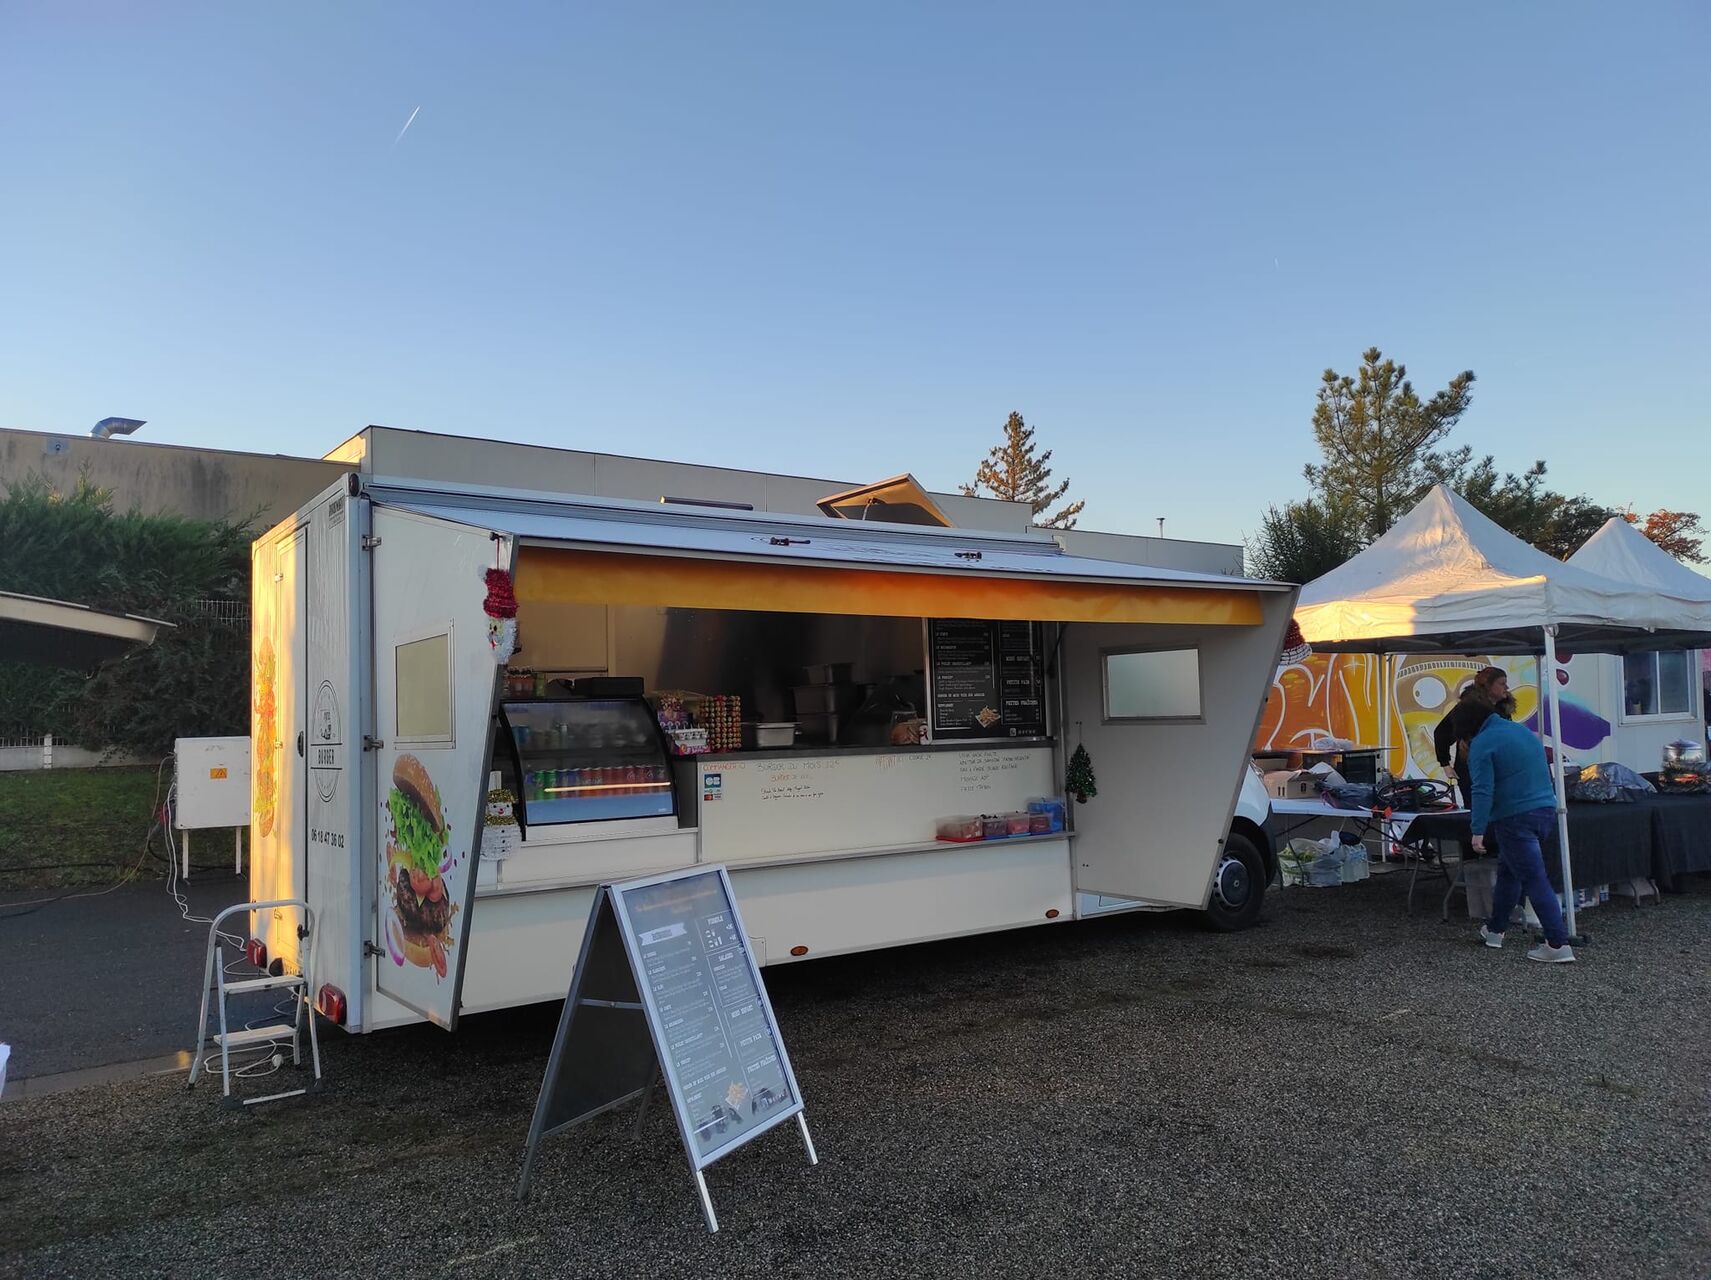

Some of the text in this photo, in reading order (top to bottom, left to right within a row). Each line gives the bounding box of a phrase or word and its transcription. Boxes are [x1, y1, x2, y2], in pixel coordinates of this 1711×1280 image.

[318, 748, 335, 765] BURGER
[311, 828, 345, 849] 06 18 47 36 02
